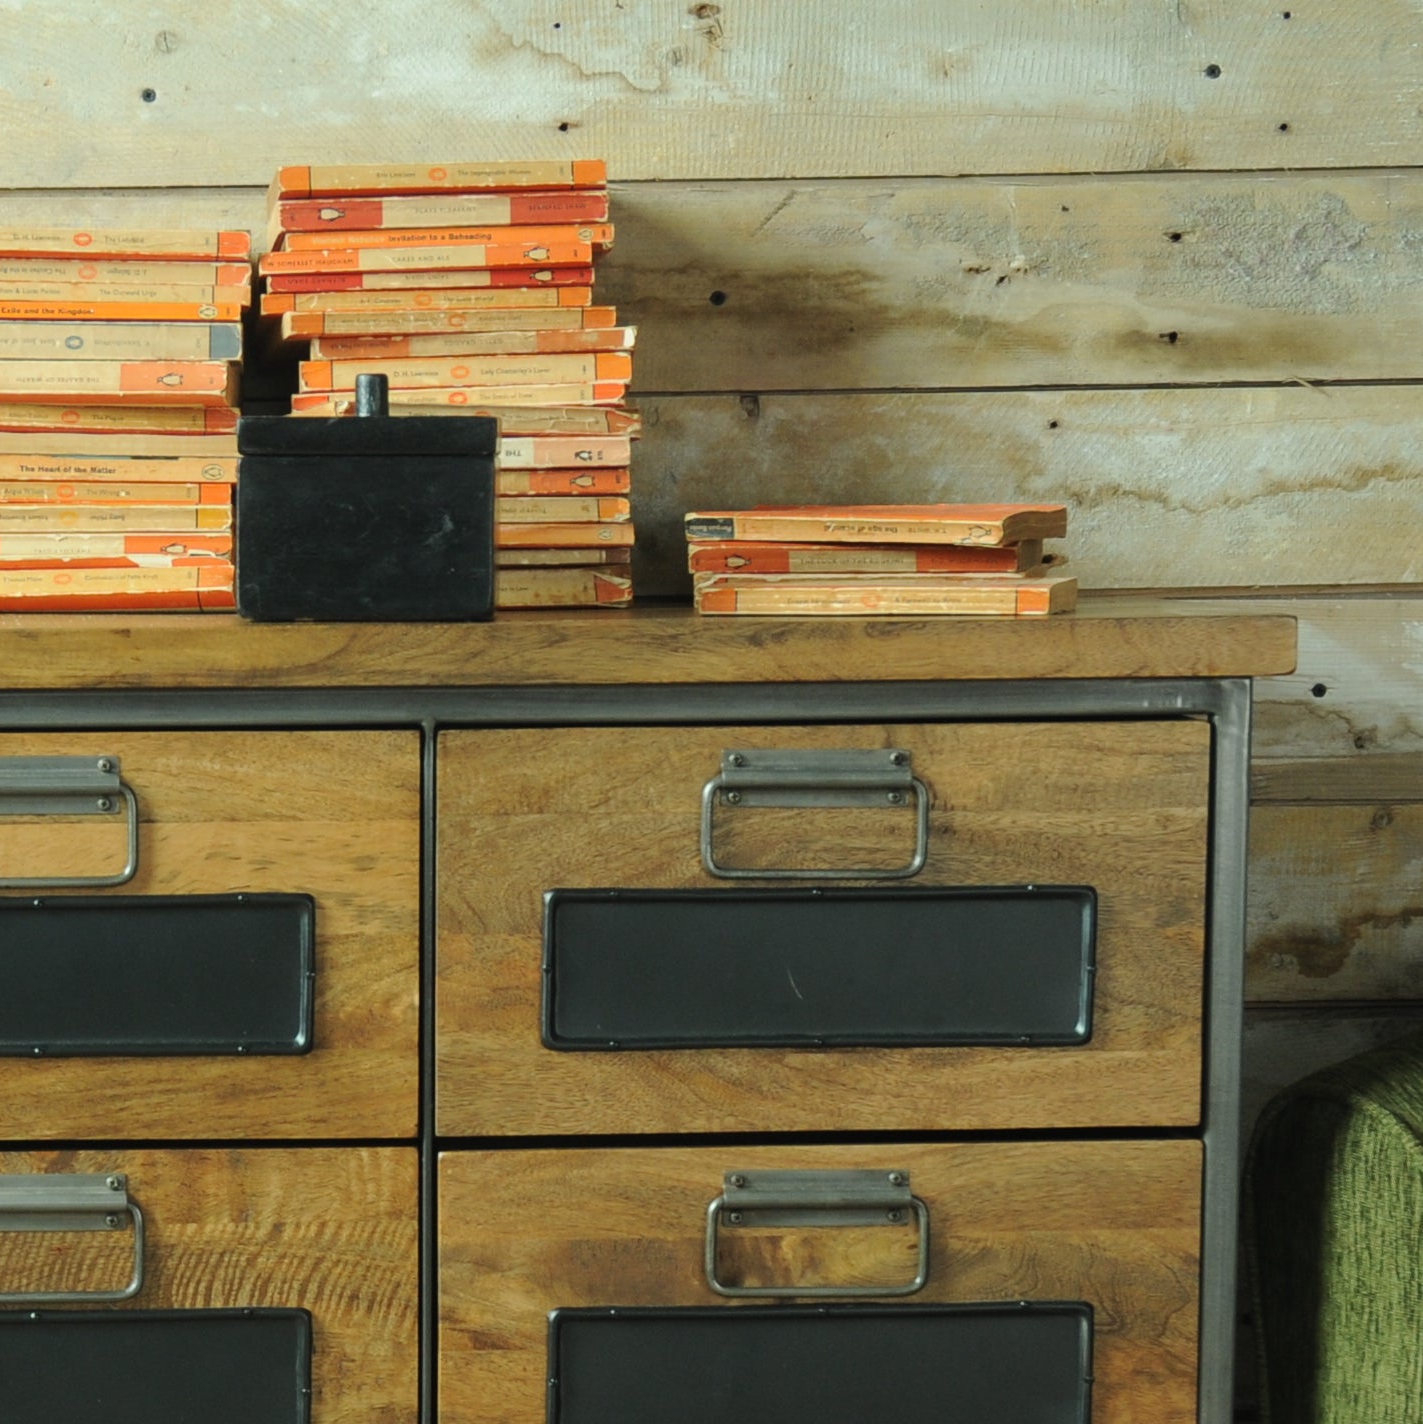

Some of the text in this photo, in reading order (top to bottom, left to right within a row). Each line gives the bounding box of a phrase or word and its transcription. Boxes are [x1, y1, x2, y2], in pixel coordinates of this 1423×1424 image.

[388, 234, 427, 242] Invitation
[315, 258, 353, 266] MAUGHAM
[90, 466, 117, 474] Matter
